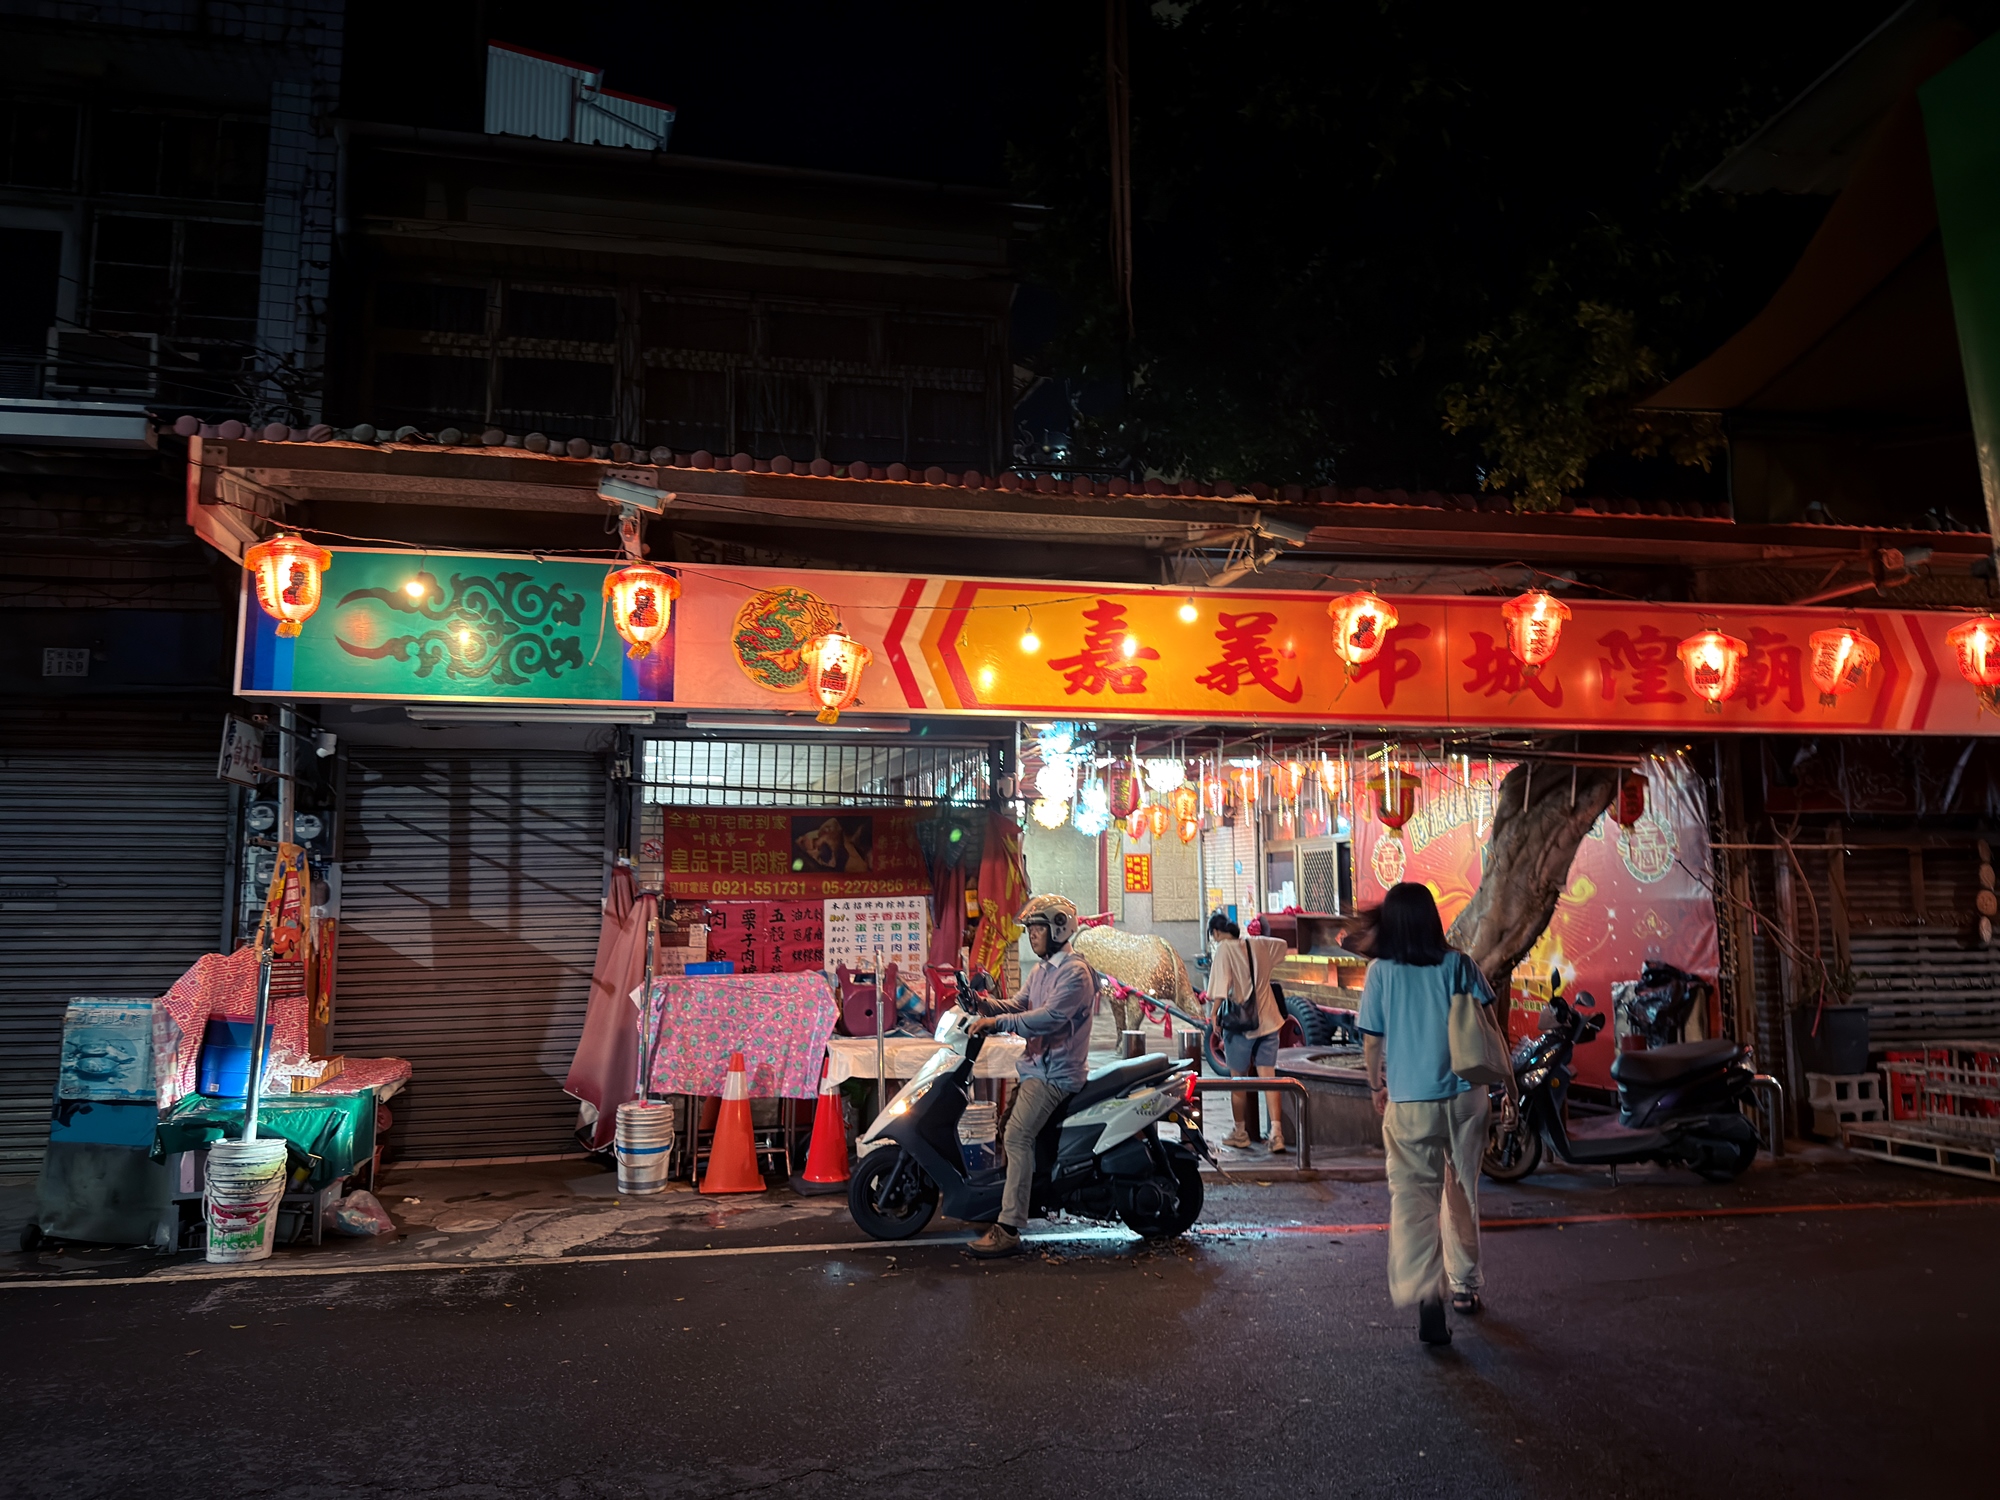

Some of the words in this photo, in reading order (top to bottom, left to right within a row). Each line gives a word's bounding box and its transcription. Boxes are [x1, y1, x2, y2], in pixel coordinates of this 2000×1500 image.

[669, 812, 787, 830] 全省可宅配到家
[693, 832, 766, 847] 叫我第一名
[669, 848, 789, 875] 皇品干貝肉粽
[712, 880, 806, 895] 0921-551731
